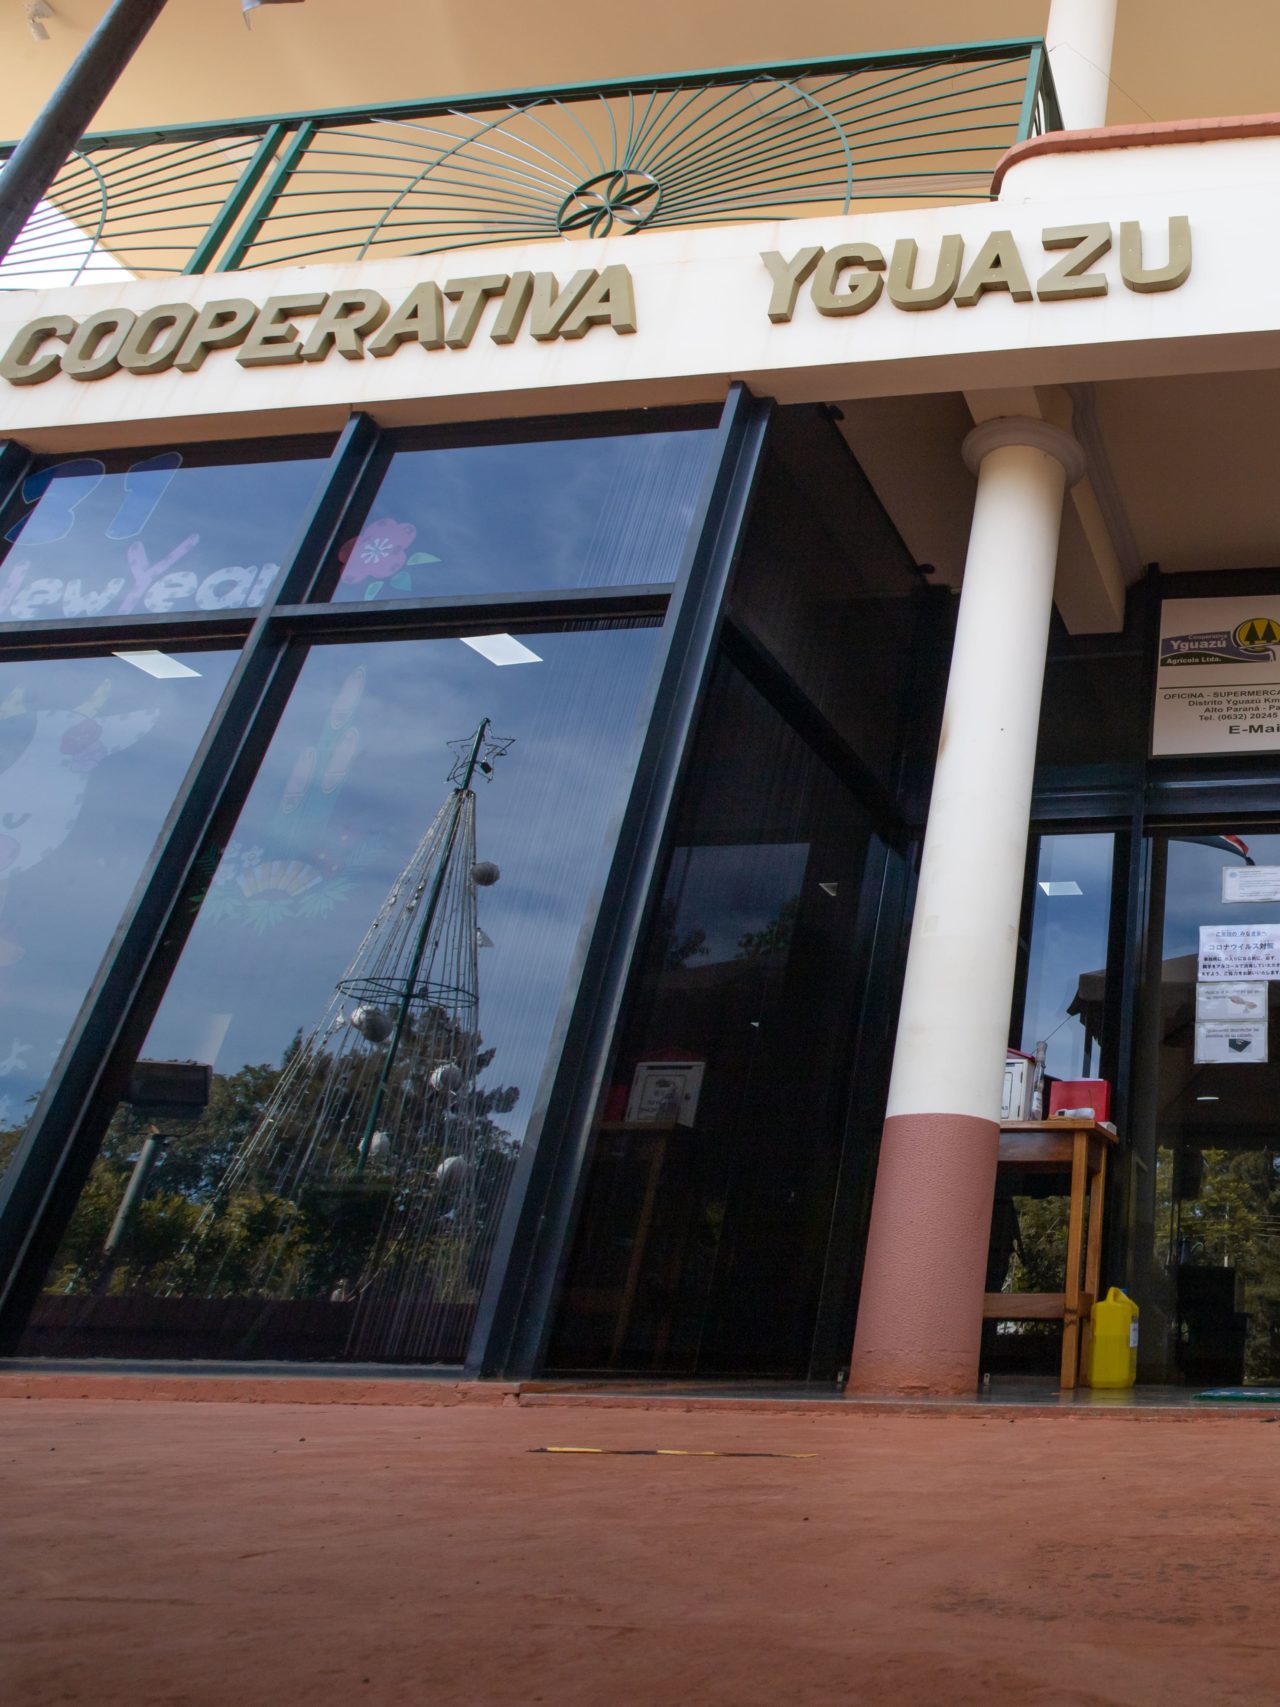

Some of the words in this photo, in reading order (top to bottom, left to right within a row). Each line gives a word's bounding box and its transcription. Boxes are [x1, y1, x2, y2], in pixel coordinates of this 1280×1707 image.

[0, 264, 638, 386] COOPERATIVA
[759, 215, 1193, 325] YGUAZU
[1170, 638, 1227, 651] Yguazú
[1163, 692, 1205, 700] OFICINA
[1188, 699, 1223, 707] Distrito
[1204, 706, 1224, 714] Alto
[1218, 713, 1247, 721] (0632)
[1249, 711, 1278, 719] 20245
